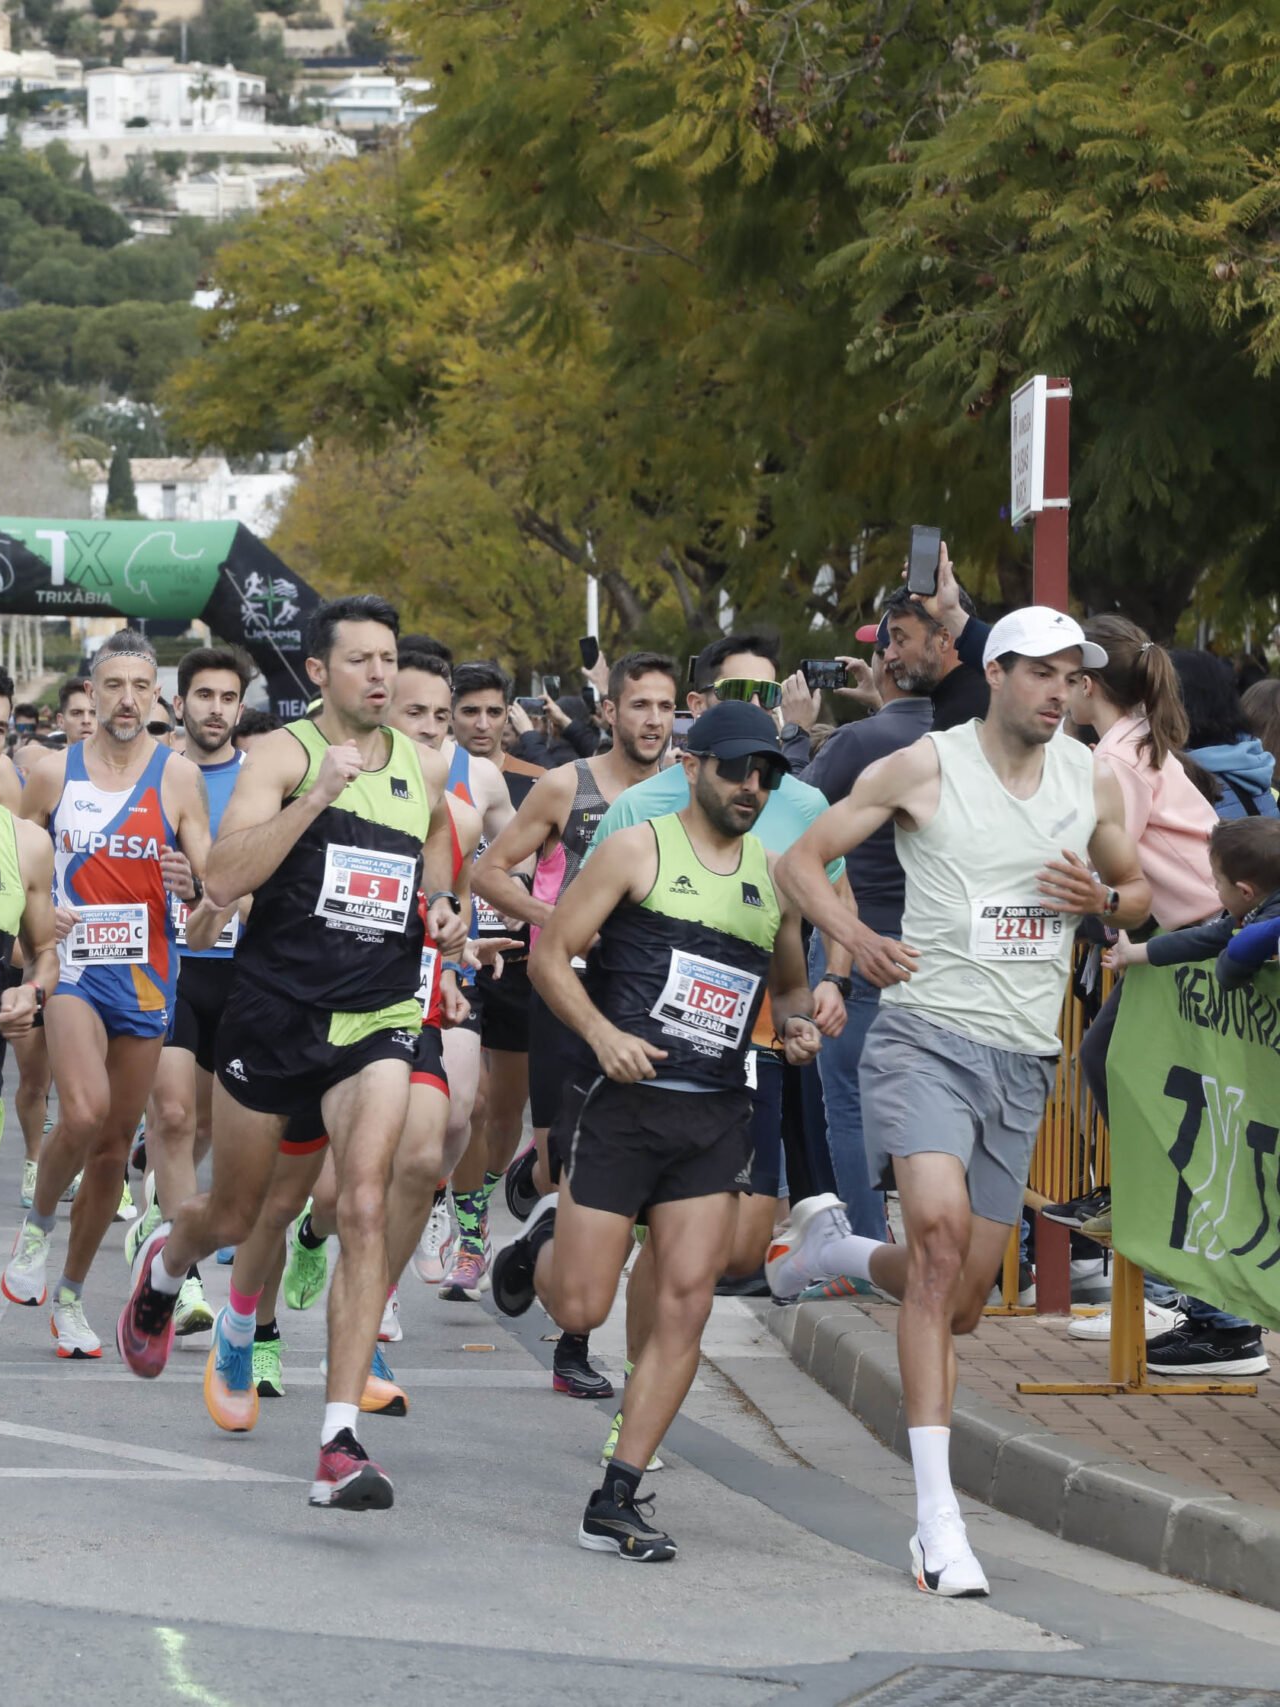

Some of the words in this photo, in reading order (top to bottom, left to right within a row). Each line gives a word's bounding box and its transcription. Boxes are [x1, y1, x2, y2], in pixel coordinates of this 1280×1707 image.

[35, 587, 113, 605] TRIXÀBIA
[61, 830, 160, 861] ALPESA
[367, 879, 381, 898] 5
[402, 885, 409, 901] B
[1006, 908, 1027, 917] SOM
[89, 923, 130, 944] 1509
[134, 927, 143, 939] C
[997, 919, 1042, 938] 2241
[88, 948, 128, 957] BALEARIA
[690, 986, 737, 1015] 1507
[738, 1001, 746, 1016] S
[681, 1012, 726, 1033] BALEARIA
